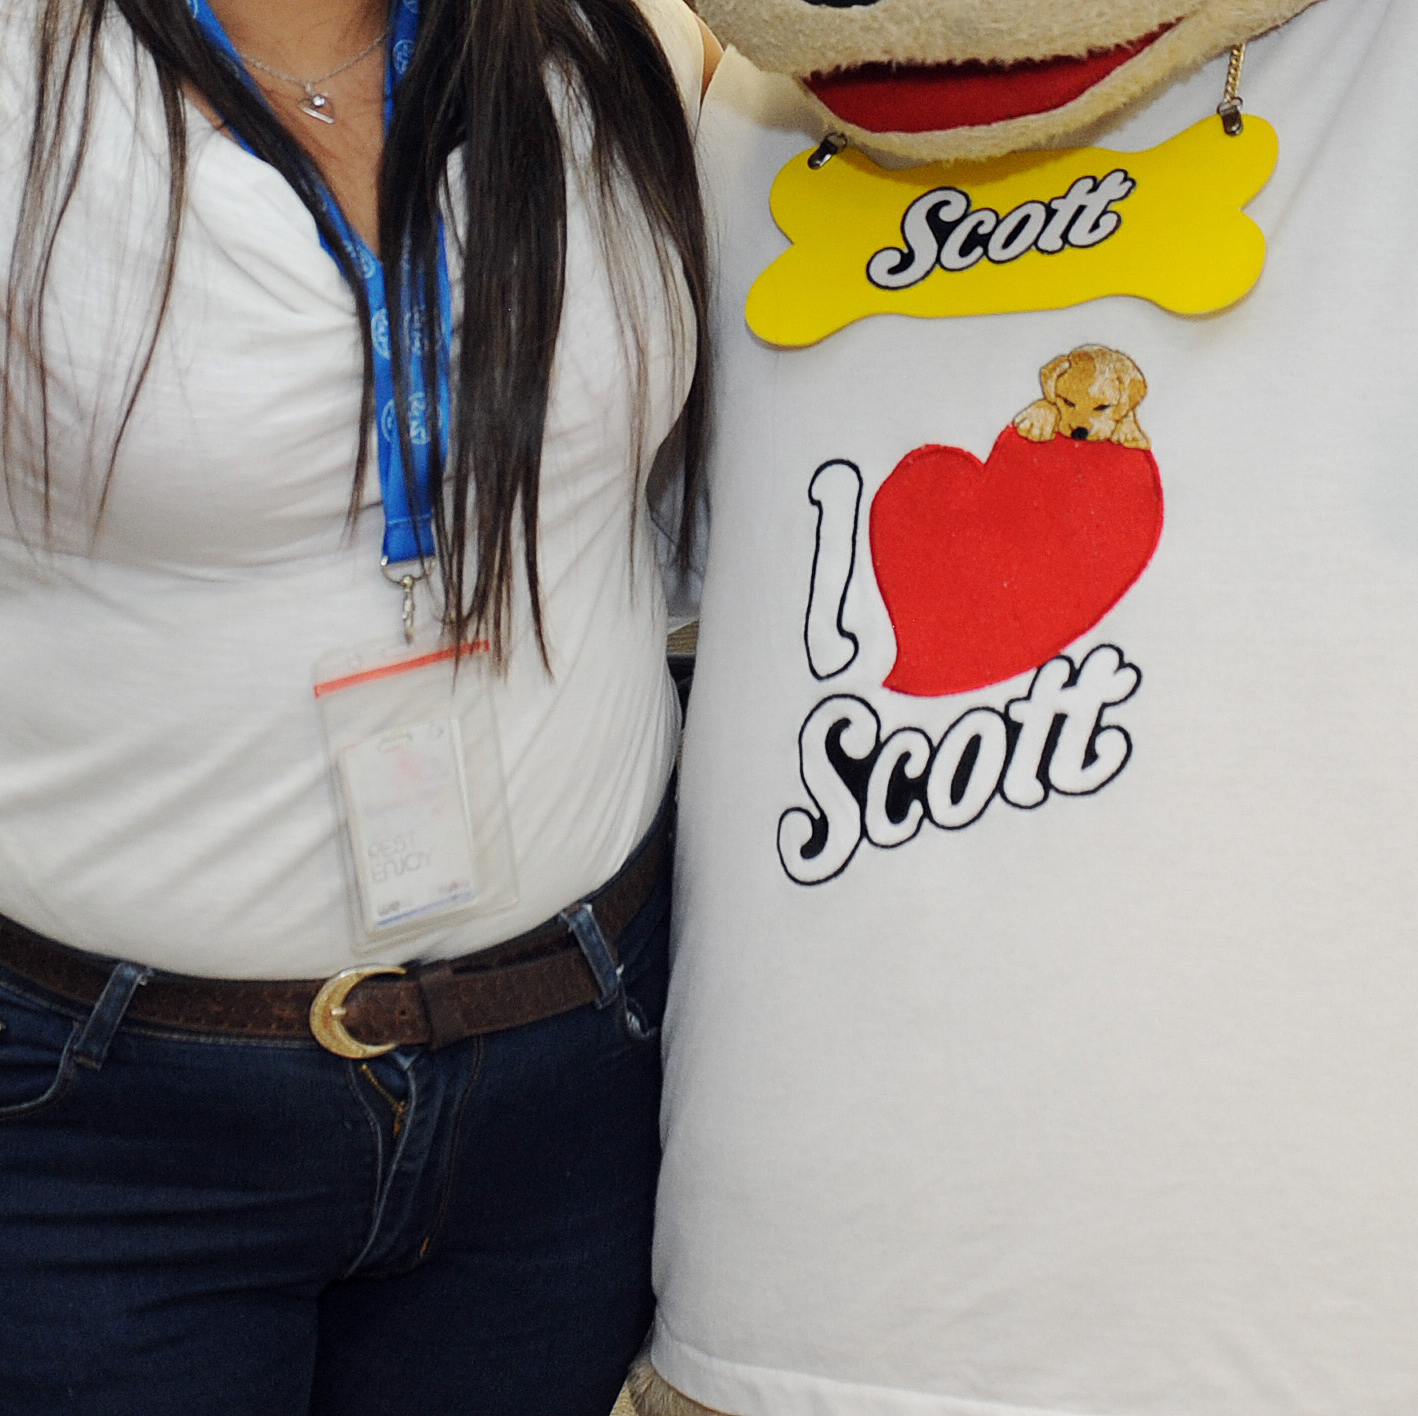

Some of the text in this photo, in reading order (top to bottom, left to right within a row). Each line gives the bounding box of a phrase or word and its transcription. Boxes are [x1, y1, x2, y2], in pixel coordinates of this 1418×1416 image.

[865, 167, 1138, 291] Scott
[803, 457, 864, 681] I
[775, 642, 1144, 887] Scott
